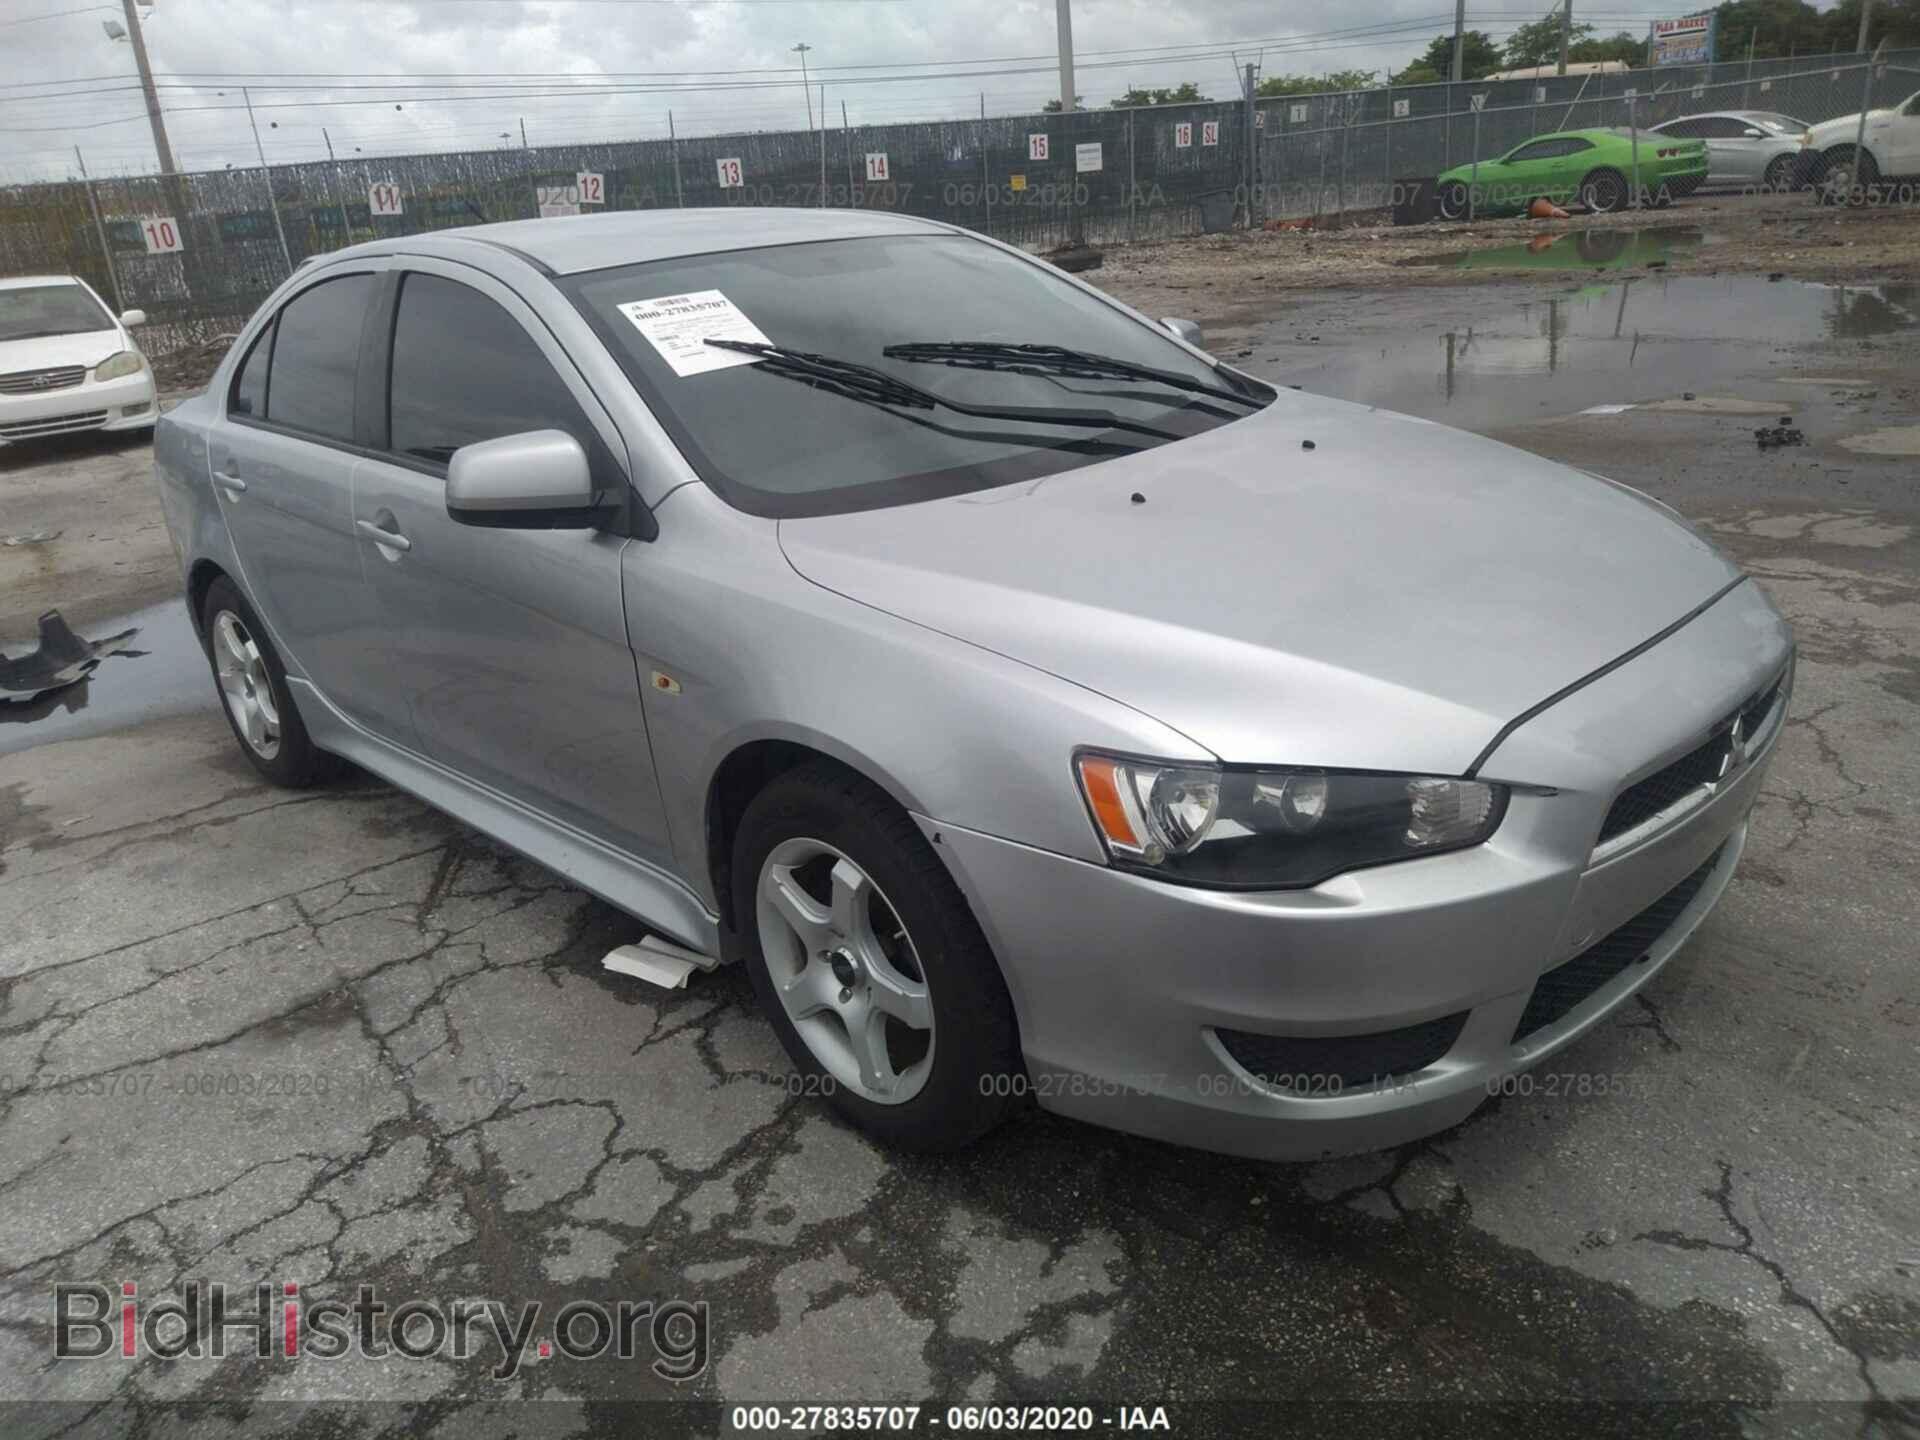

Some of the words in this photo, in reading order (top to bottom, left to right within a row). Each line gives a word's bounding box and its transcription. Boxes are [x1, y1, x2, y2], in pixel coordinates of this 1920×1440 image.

[1177, 126, 1190, 145] 16
[1204, 124, 1217, 144] SL
[1031, 137, 1047, 158] 15
[720, 161, 740, 185] 13
[868, 157, 887, 178] 14
[373, 185, 397, 212] 11
[580, 176, 601, 201] 12
[146, 221, 176, 250] 10
